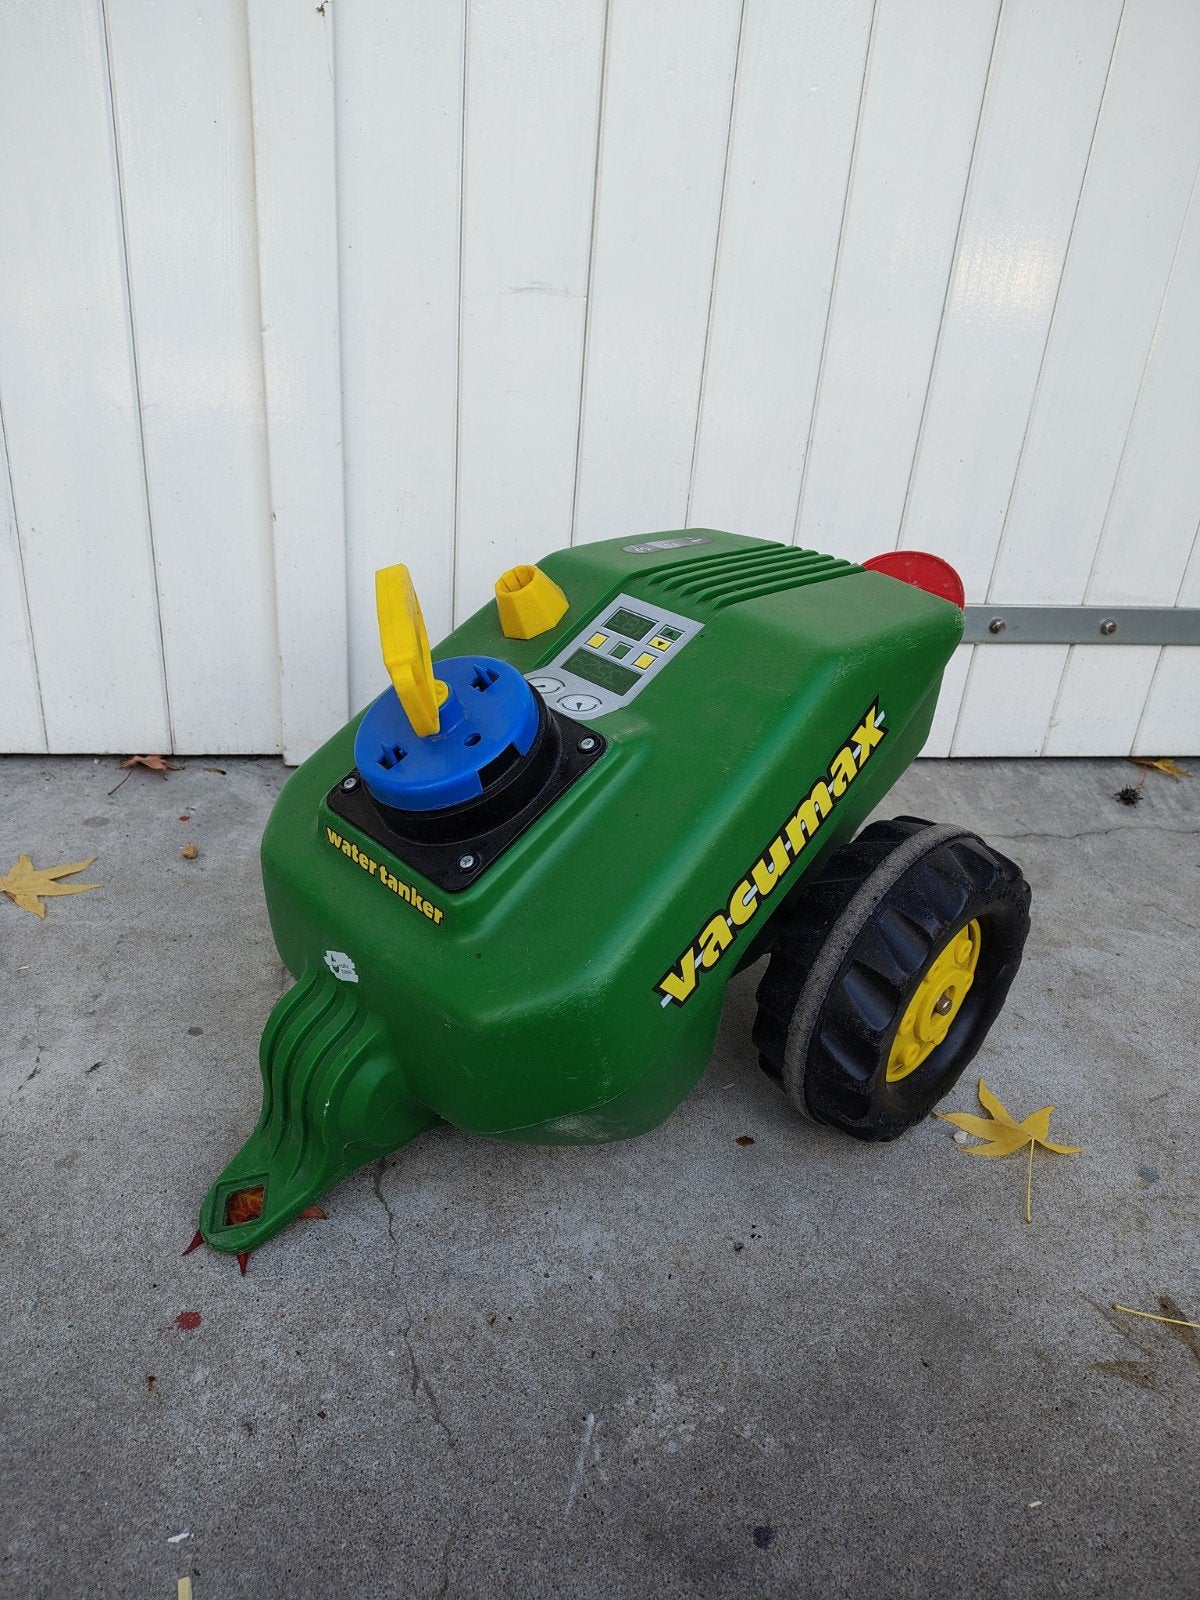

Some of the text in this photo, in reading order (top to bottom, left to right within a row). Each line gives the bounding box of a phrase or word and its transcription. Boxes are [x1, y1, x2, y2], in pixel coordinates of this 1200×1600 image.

[326, 826, 443, 925] water tanker
[656, 702, 887, 1004] vacumax
